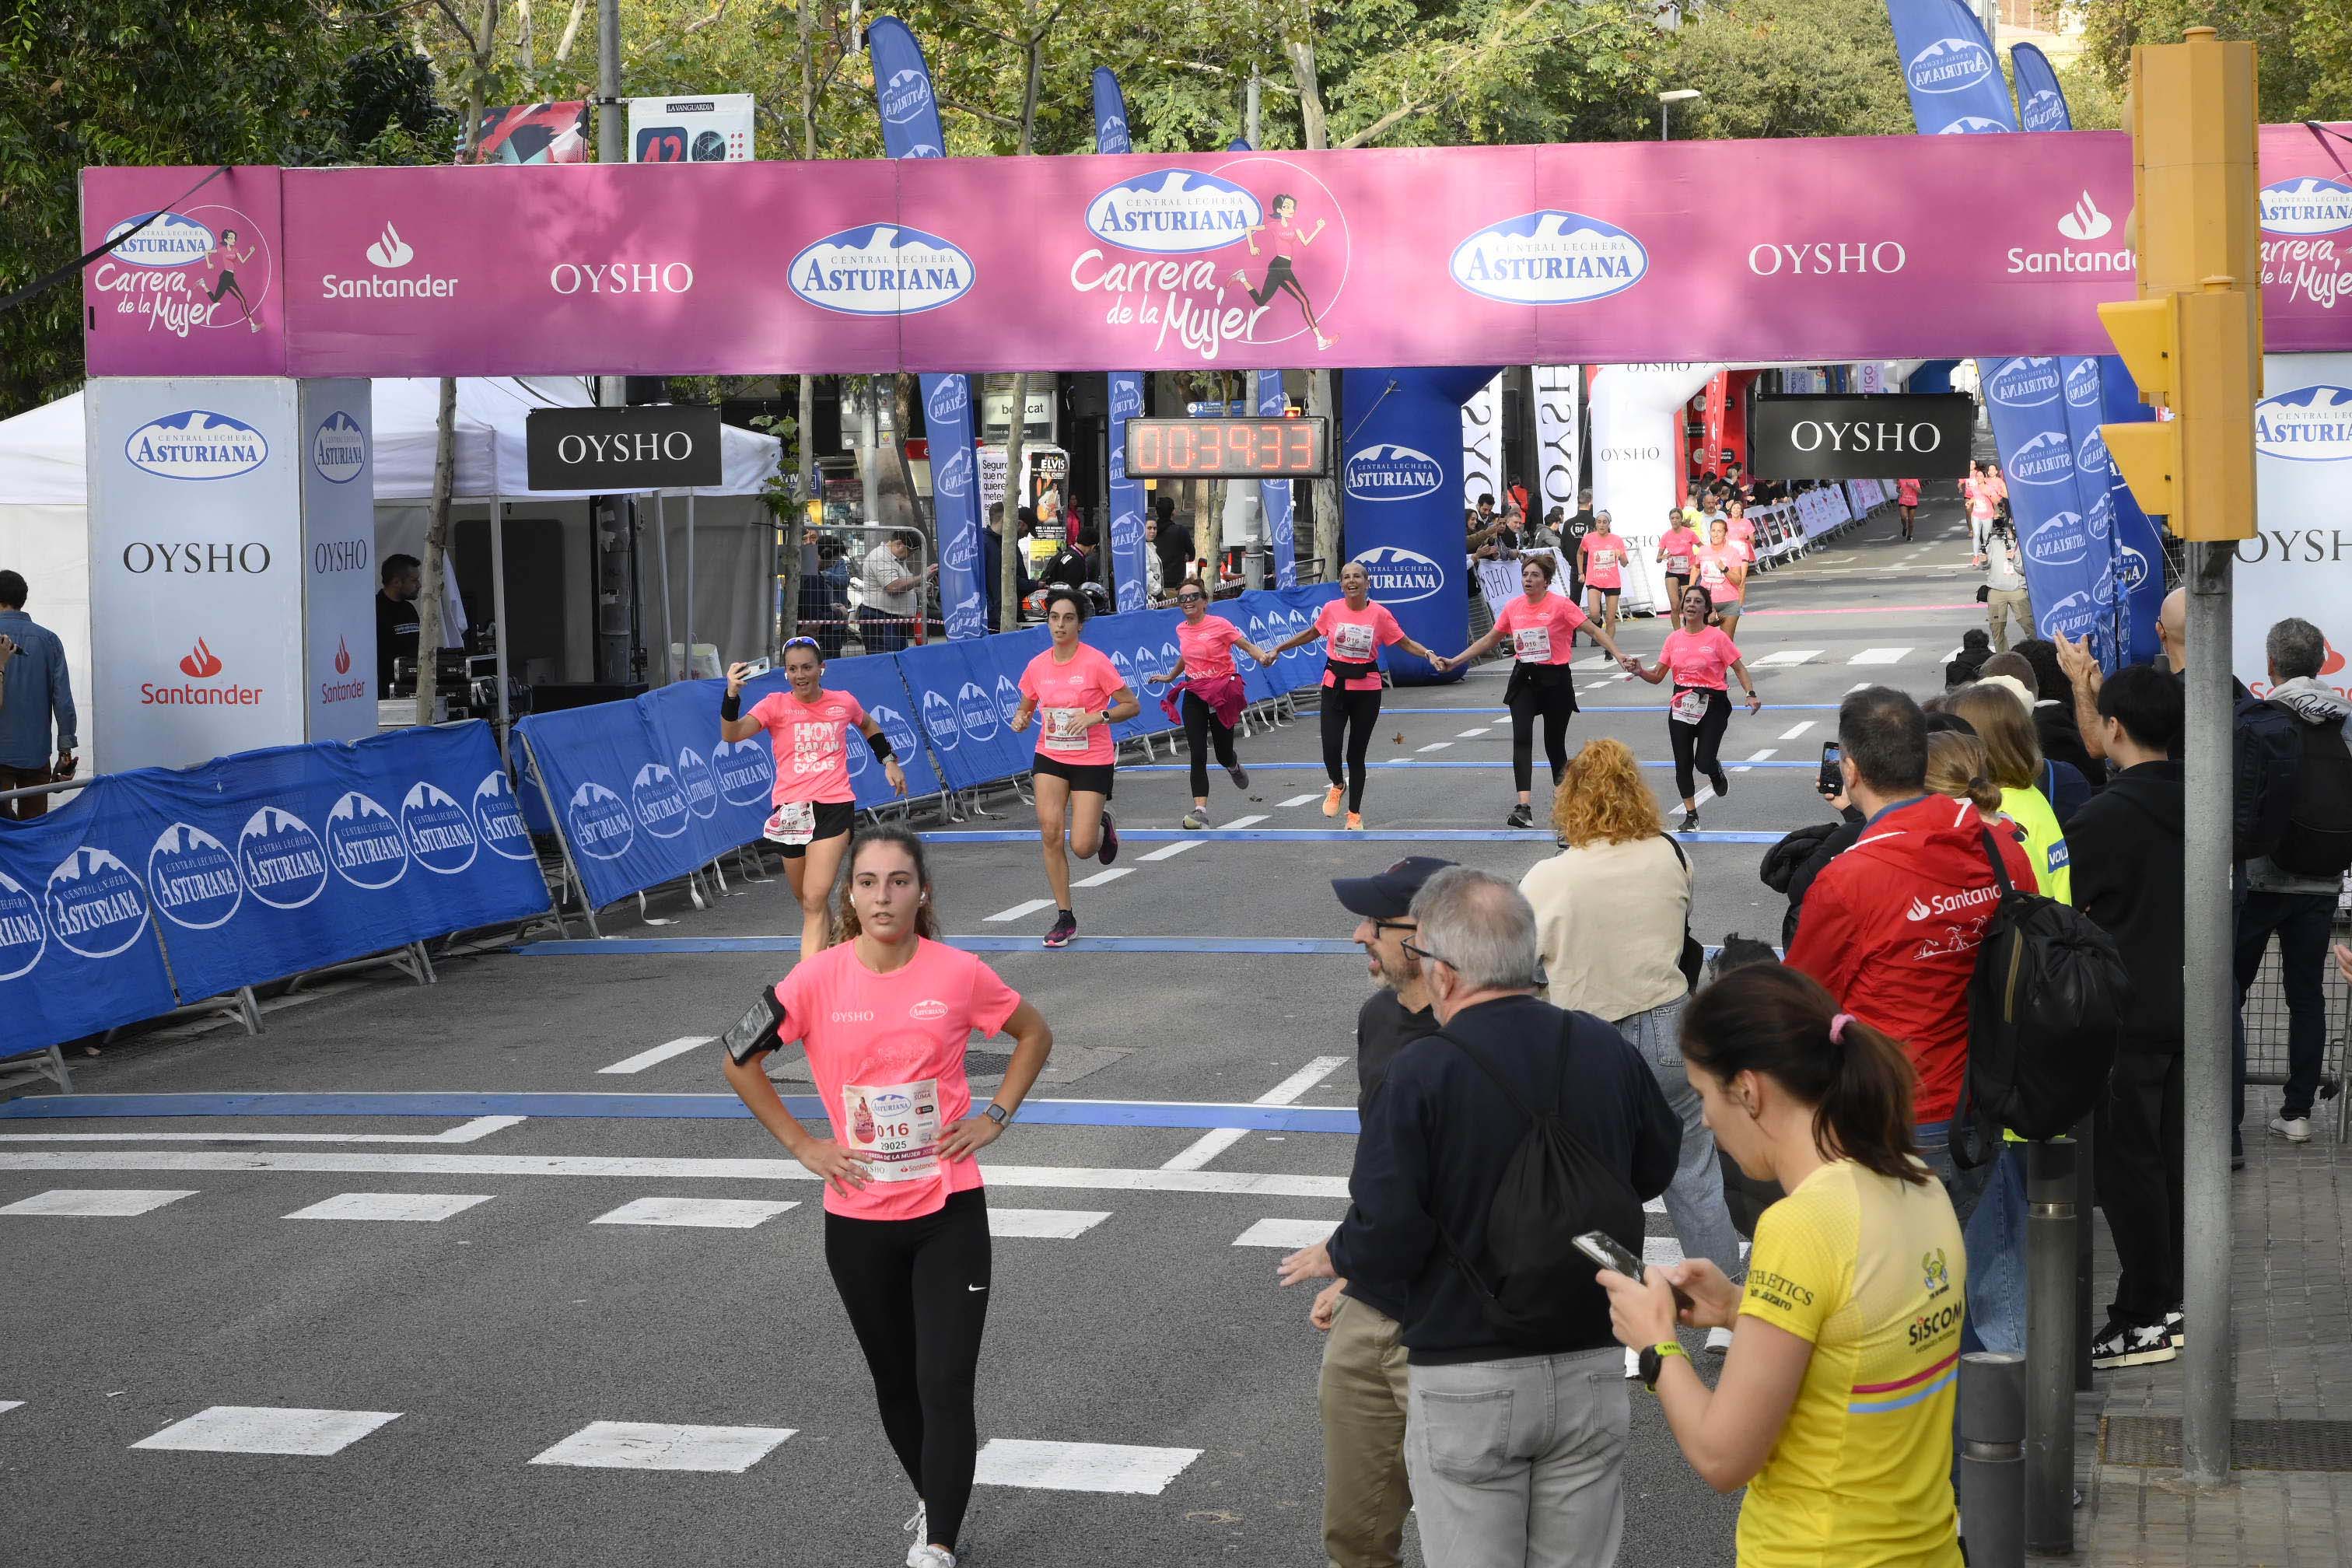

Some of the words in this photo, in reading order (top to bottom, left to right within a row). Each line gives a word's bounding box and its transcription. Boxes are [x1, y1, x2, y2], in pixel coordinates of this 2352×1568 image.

[675, 103, 714, 111] VANGUARDIA
[1125, 198, 1182, 207] CENTRAL
[1187, 197, 1244, 206] LECHERA
[1099, 201, 1249, 233] ASTURIANA
[113, 233, 206, 253] ASTURIANA
[1495, 242, 1557, 253] CENTRAL
[1563, 240, 1626, 252] LECHERA
[2260, 239, 2335, 262] arrera
[831, 255, 890, 264] CENTRAL
[894, 254, 955, 264] LECHERA
[1070, 248, 1218, 292] Carrera
[1465, 246, 1633, 282] ASTURIANA
[1748, 240, 1906, 276] OYSHO
[2007, 247, 2137, 274] Santand
[94, 262, 187, 292] Carrera
[323, 273, 459, 299] Santander
[550, 262, 694, 294] OYSHO
[802, 257, 961, 291] ASTURIANA
[2278, 262, 2293, 284] la
[2288, 257, 2352, 309] Muje
[117, 292, 135, 313] de
[138, 292, 151, 313] la
[148, 290, 222, 338] Mujer
[1106, 294, 1135, 324] de
[1139, 294, 1159, 324] la
[1153, 285, 1271, 360] Mujer
[1627, 362, 1691, 373] OYSHO
[2256, 414, 2352, 443] ASTURI
[2277, 411, 2328, 420] CENTRAL
[136, 436, 259, 463] ASTURIANA
[558, 431, 693, 464] OYSHO
[1139, 425, 1311, 468] 00:39:33
[1790, 421, 1941, 453] OYSHO
[317, 438, 363, 466] ASTURIANA
[1041, 459, 1065, 469] ELVIS
[1601, 446, 1661, 462] OYSHO
[983, 481, 1008, 492] quiere
[1348, 467, 1436, 488] ASTURIANA
[123, 542, 271, 574] OYSHO
[314, 538, 367, 574] OYSHO
[2235, 529, 2352, 563] OYSH
[1367, 574, 1437, 589] TURIANA
[141, 683, 263, 705] Santander
[322, 677, 365, 704] Santander
[794, 722, 840, 742] HOY
[794, 752, 817, 762] LAS
[414, 813, 437, 826] CENTRAL
[481, 807, 529, 841] ASTUR
[1953, 797, 1973, 828] 7
[340, 824, 367, 837] CENTRAL
[367, 821, 393, 833] LECHERA
[408, 820, 474, 854] ASTURIANA
[254, 842, 282, 856] CENTRAL
[282, 835, 312, 851] LECHERA
[333, 828, 405, 869] ASTURIANA
[2049, 845, 2069, 866] VOLU
[166, 858, 196, 873] CENTRAL
[198, 853, 226, 868] LECHERA
[247, 849, 324, 888] ASTURIANA
[156, 867, 238, 908] ASTURIANA
[0, 898, 27, 911] ECHERA
[54, 889, 142, 937] ASTURIANA
[832, 1010, 874, 1022] OYSHO
[874, 1101, 908, 1112] ASTURIANA
[877, 1122, 909, 1138] 016
